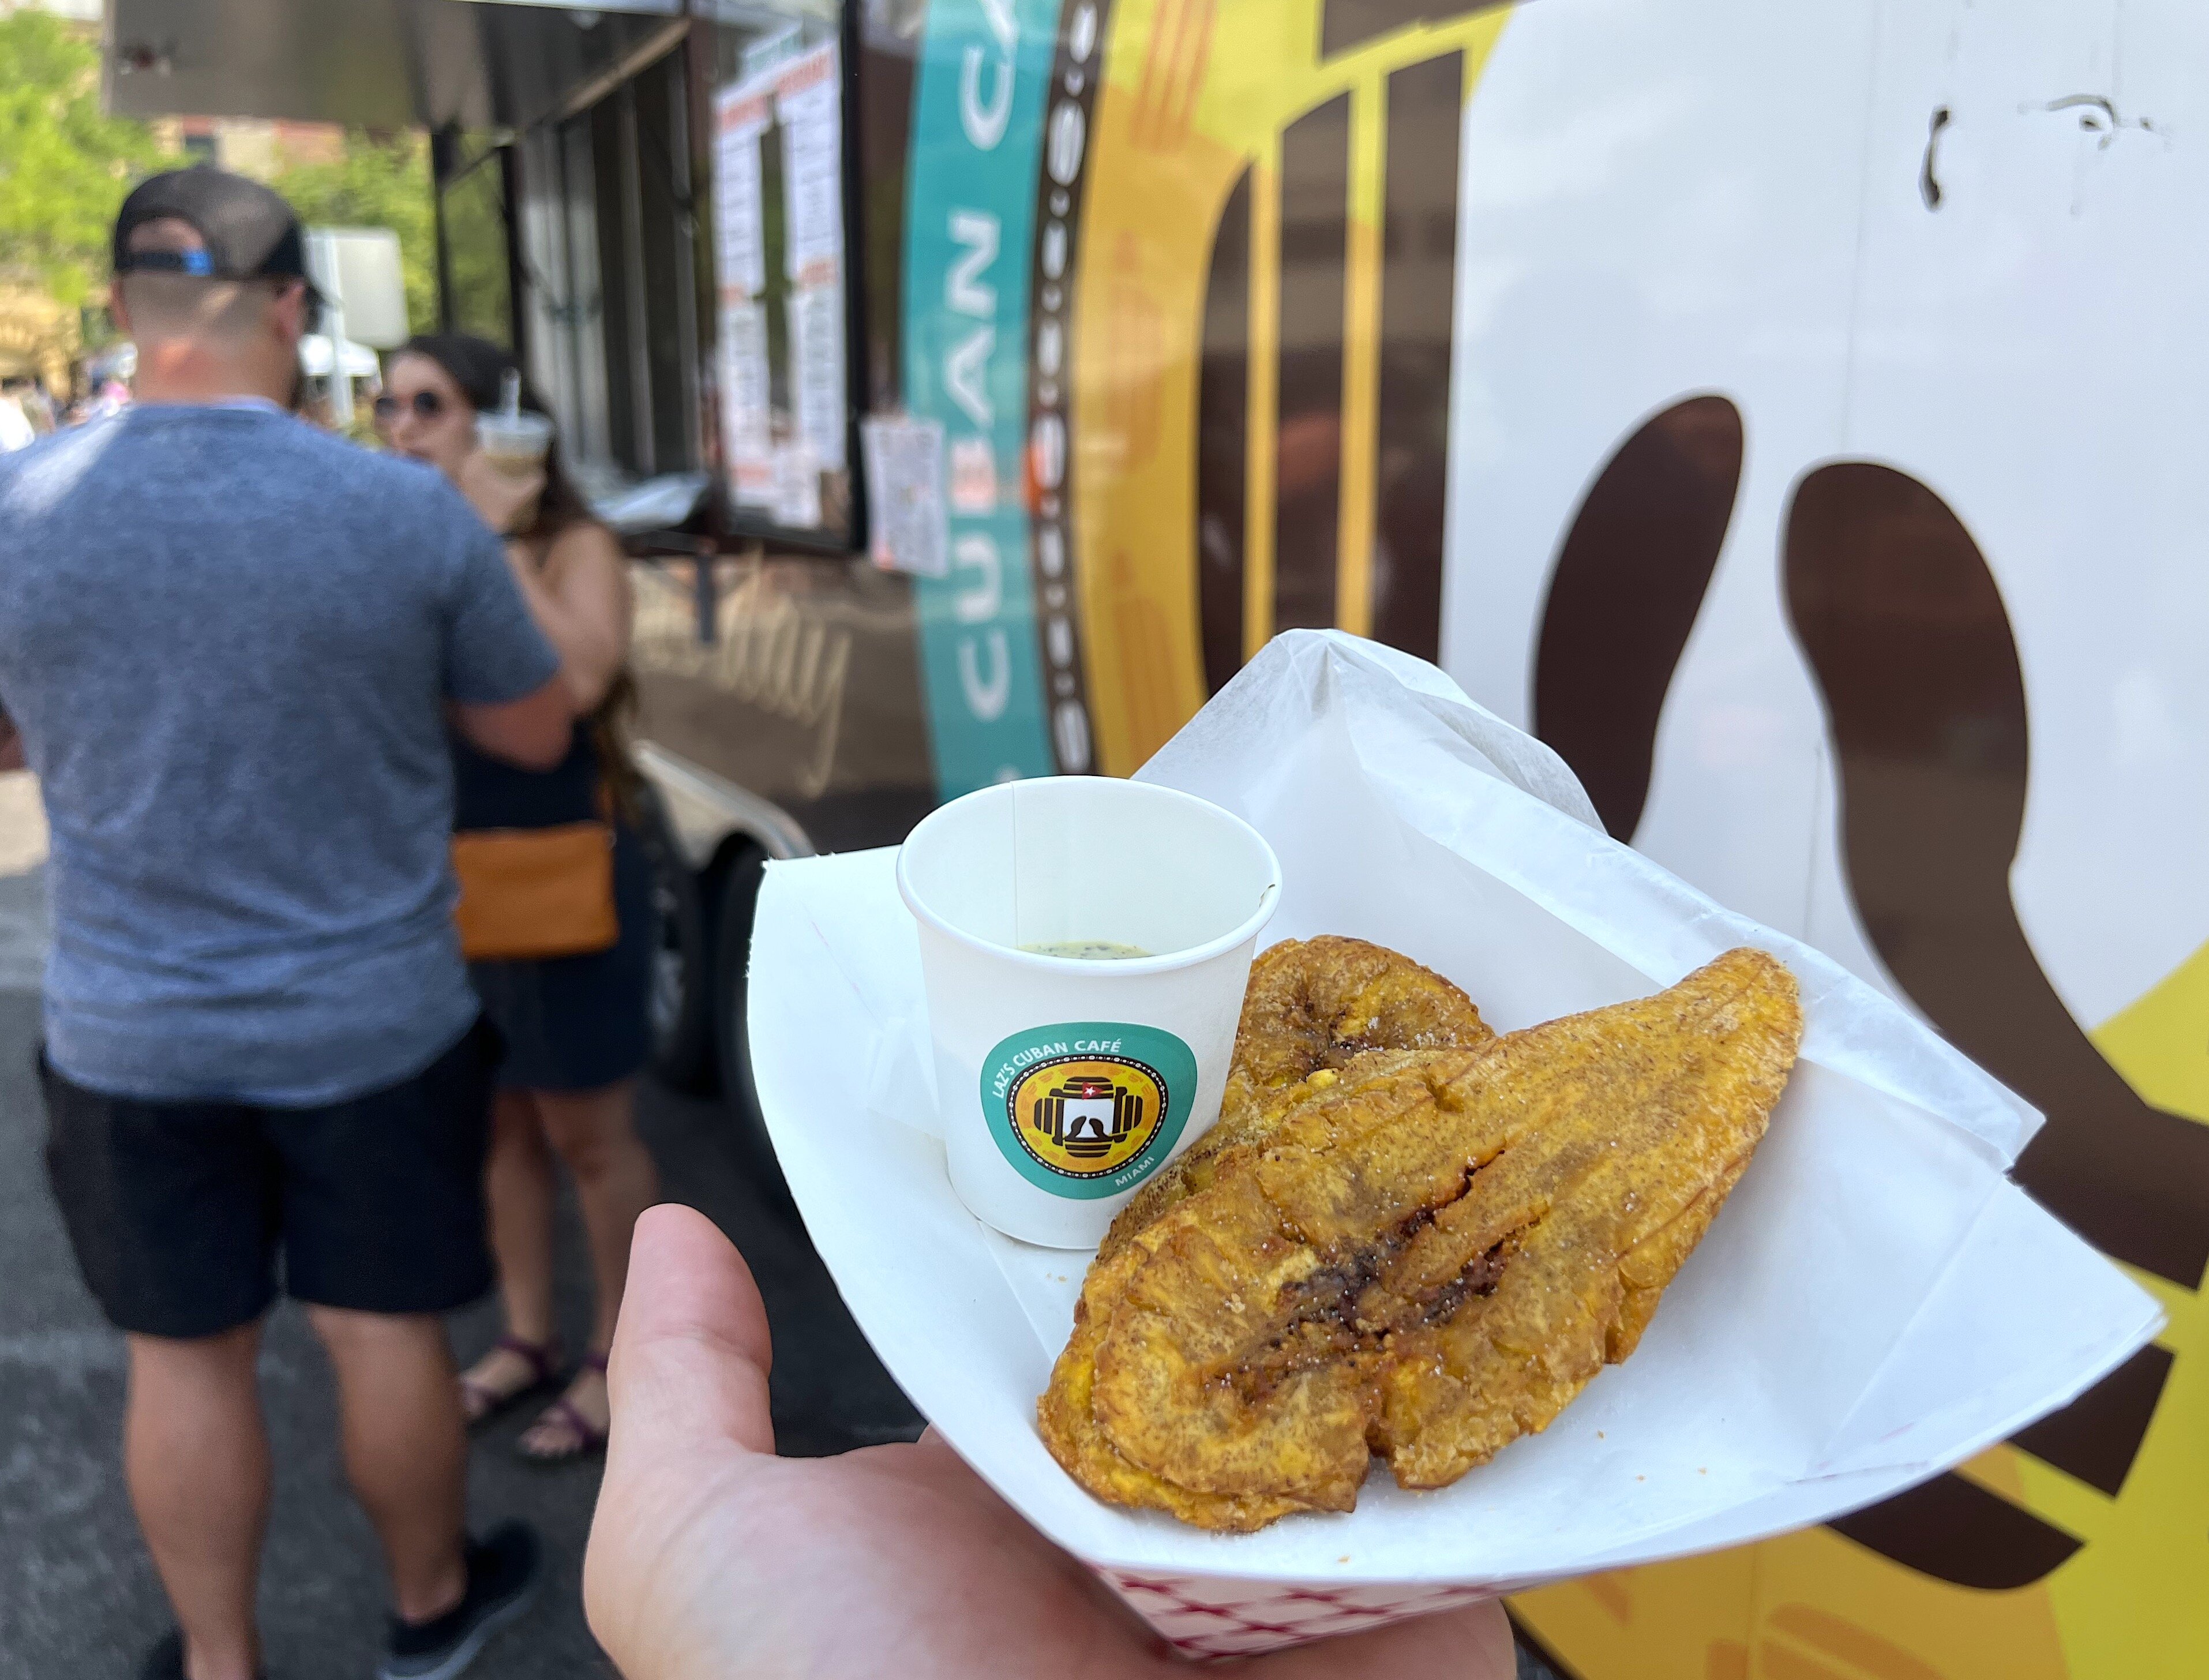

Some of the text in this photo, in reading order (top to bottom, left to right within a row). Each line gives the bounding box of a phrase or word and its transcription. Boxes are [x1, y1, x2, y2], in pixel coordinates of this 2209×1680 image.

[943, 207, 1014, 722] CUBAN
[992, 1038, 1122, 1099] LAZ'S CUBAN CAFÉ
[1115, 1156, 1154, 1187] MIAMI
